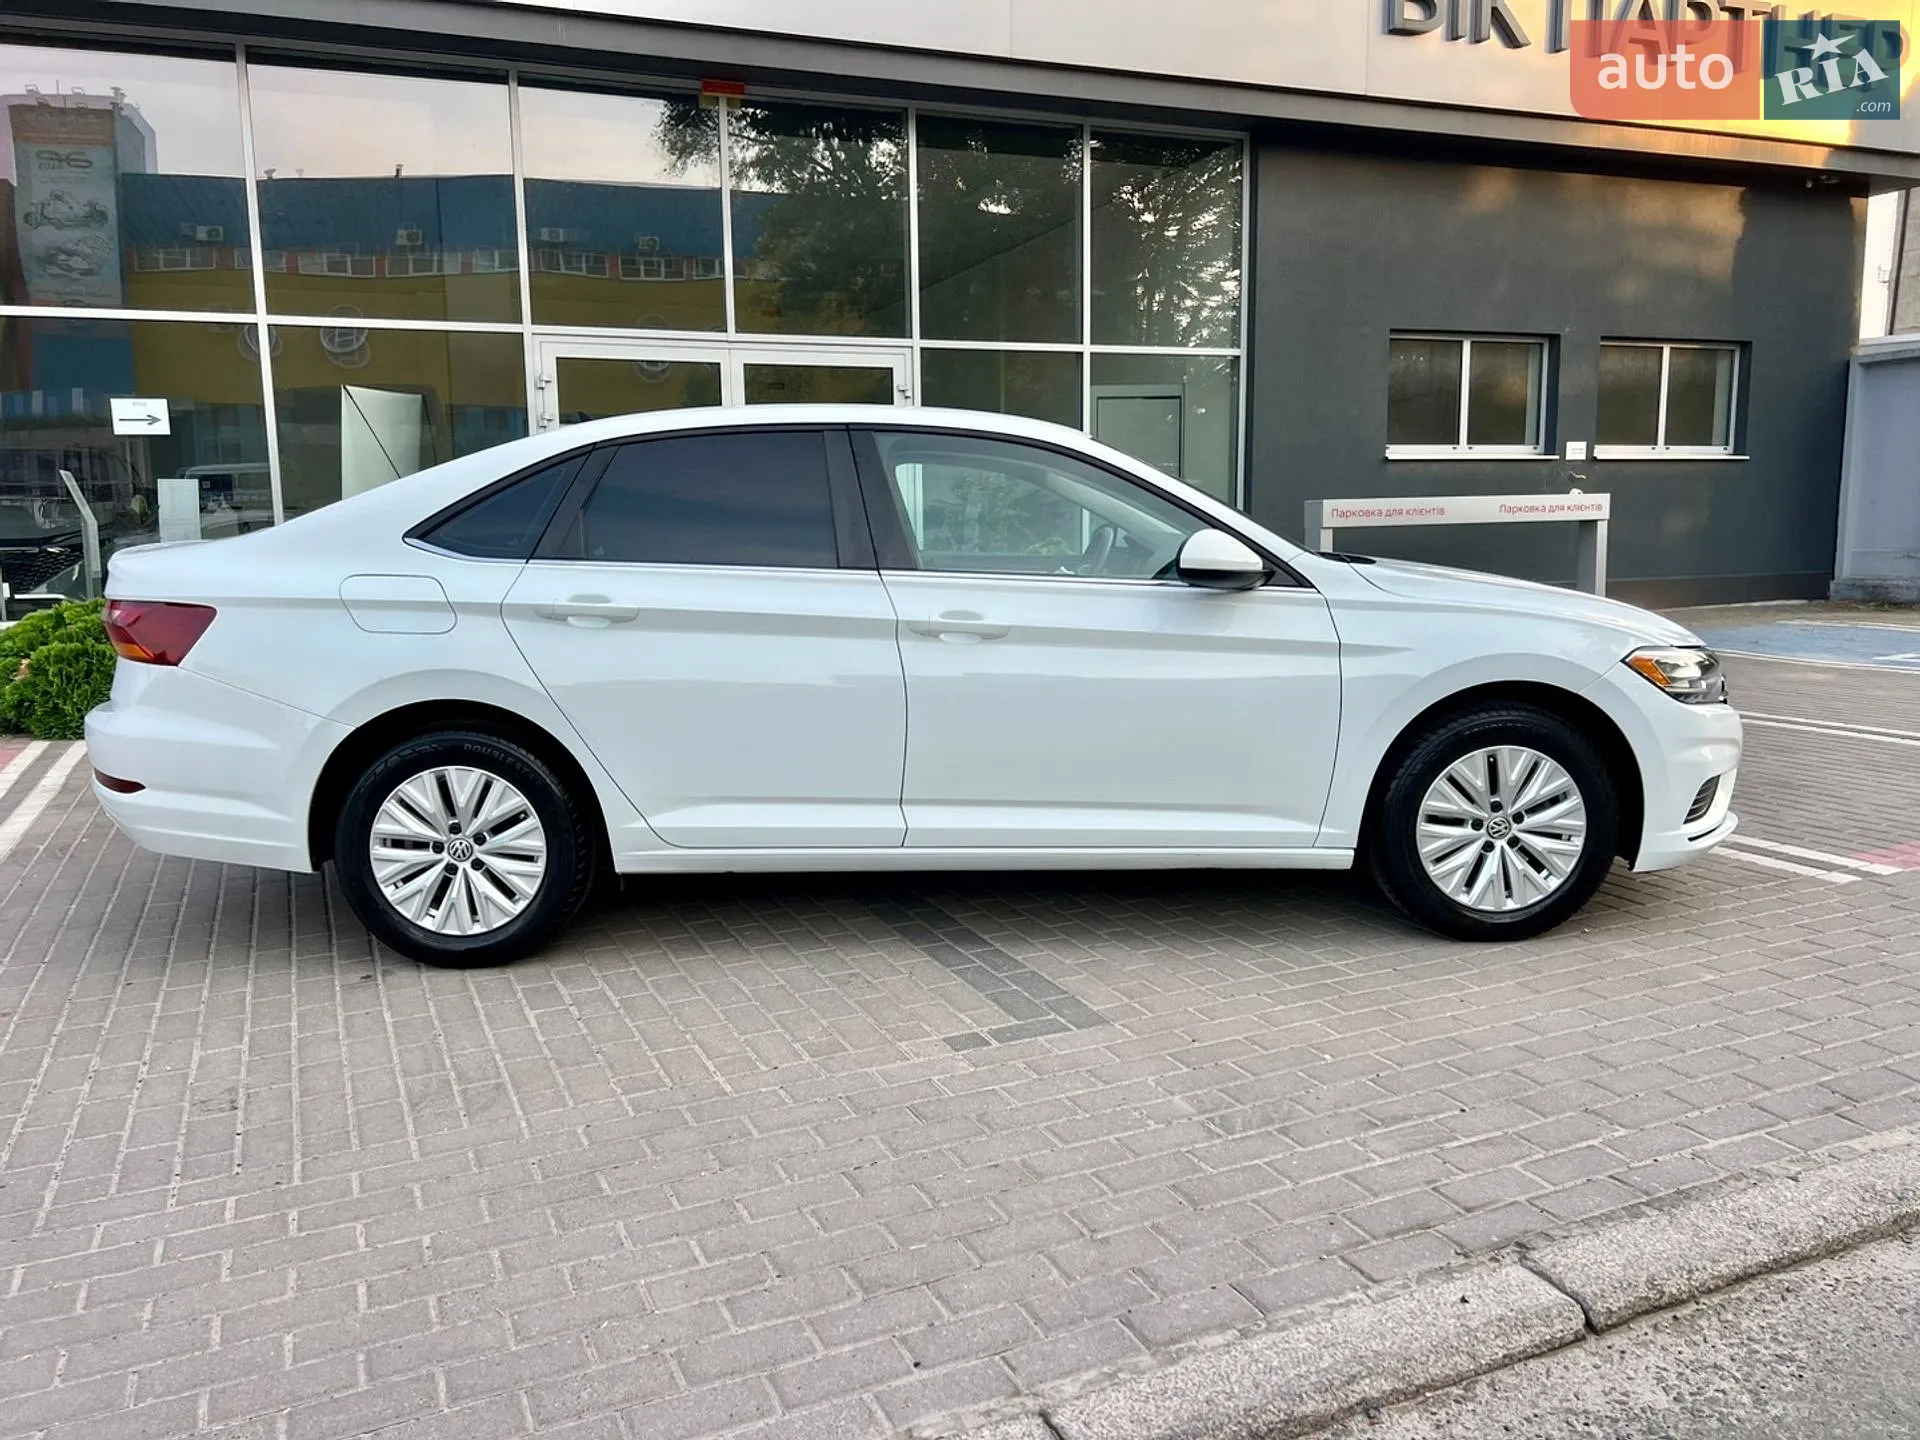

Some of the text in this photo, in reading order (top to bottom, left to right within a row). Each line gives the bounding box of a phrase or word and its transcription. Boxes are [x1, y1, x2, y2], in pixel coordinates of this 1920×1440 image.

[1331, 506, 1446, 519] Парковка для клієнтів
[1499, 503, 1547, 515] Парковка
[1548, 504, 1565, 513] для
